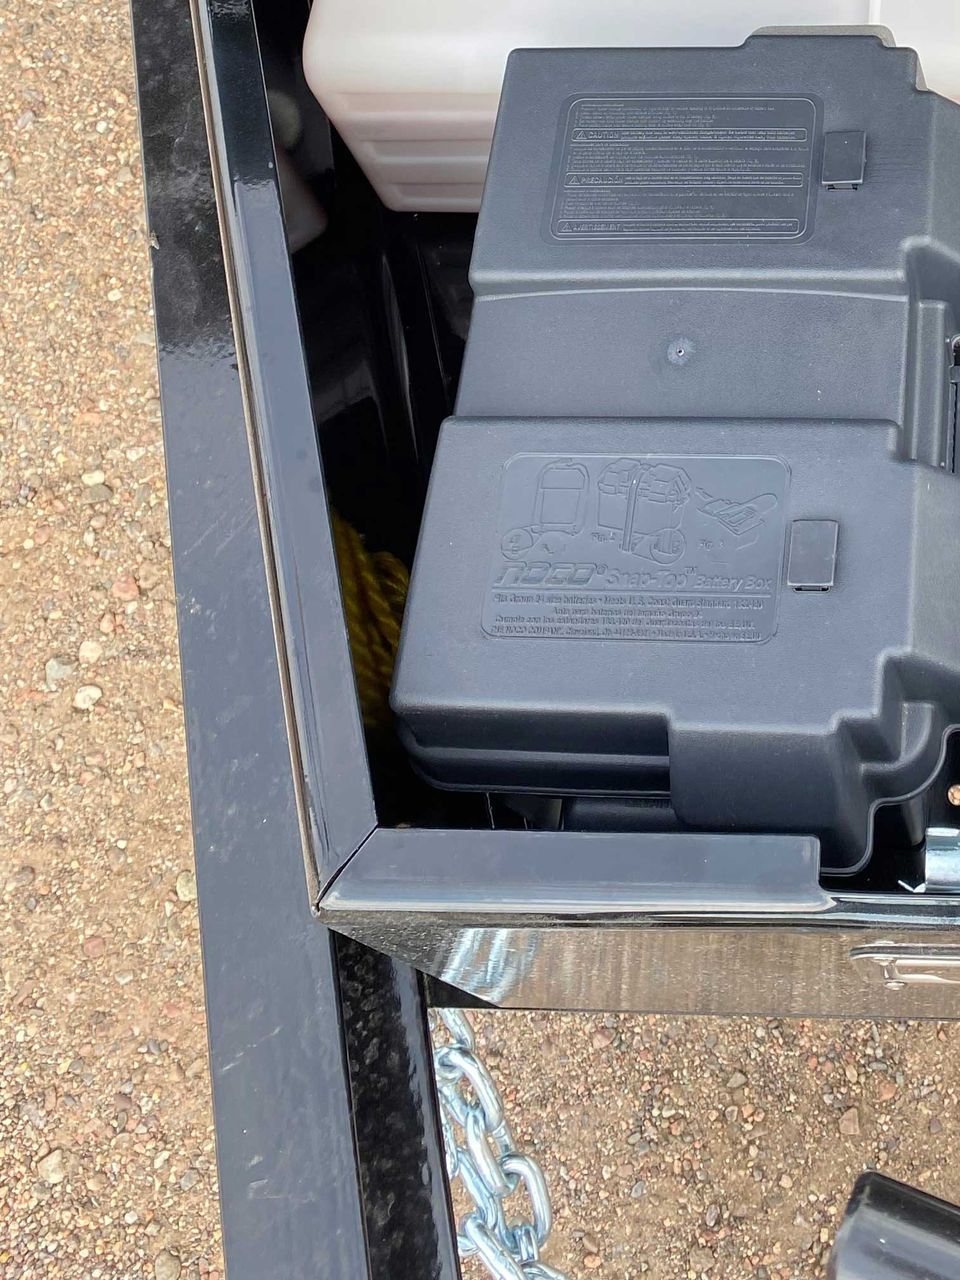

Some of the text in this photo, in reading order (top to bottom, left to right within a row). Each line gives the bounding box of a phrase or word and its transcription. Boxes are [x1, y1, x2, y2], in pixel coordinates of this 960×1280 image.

[588, 131, 619, 140] CAUTION
[694, 574, 743, 592] Battery
[744, 574, 773, 591] Box
